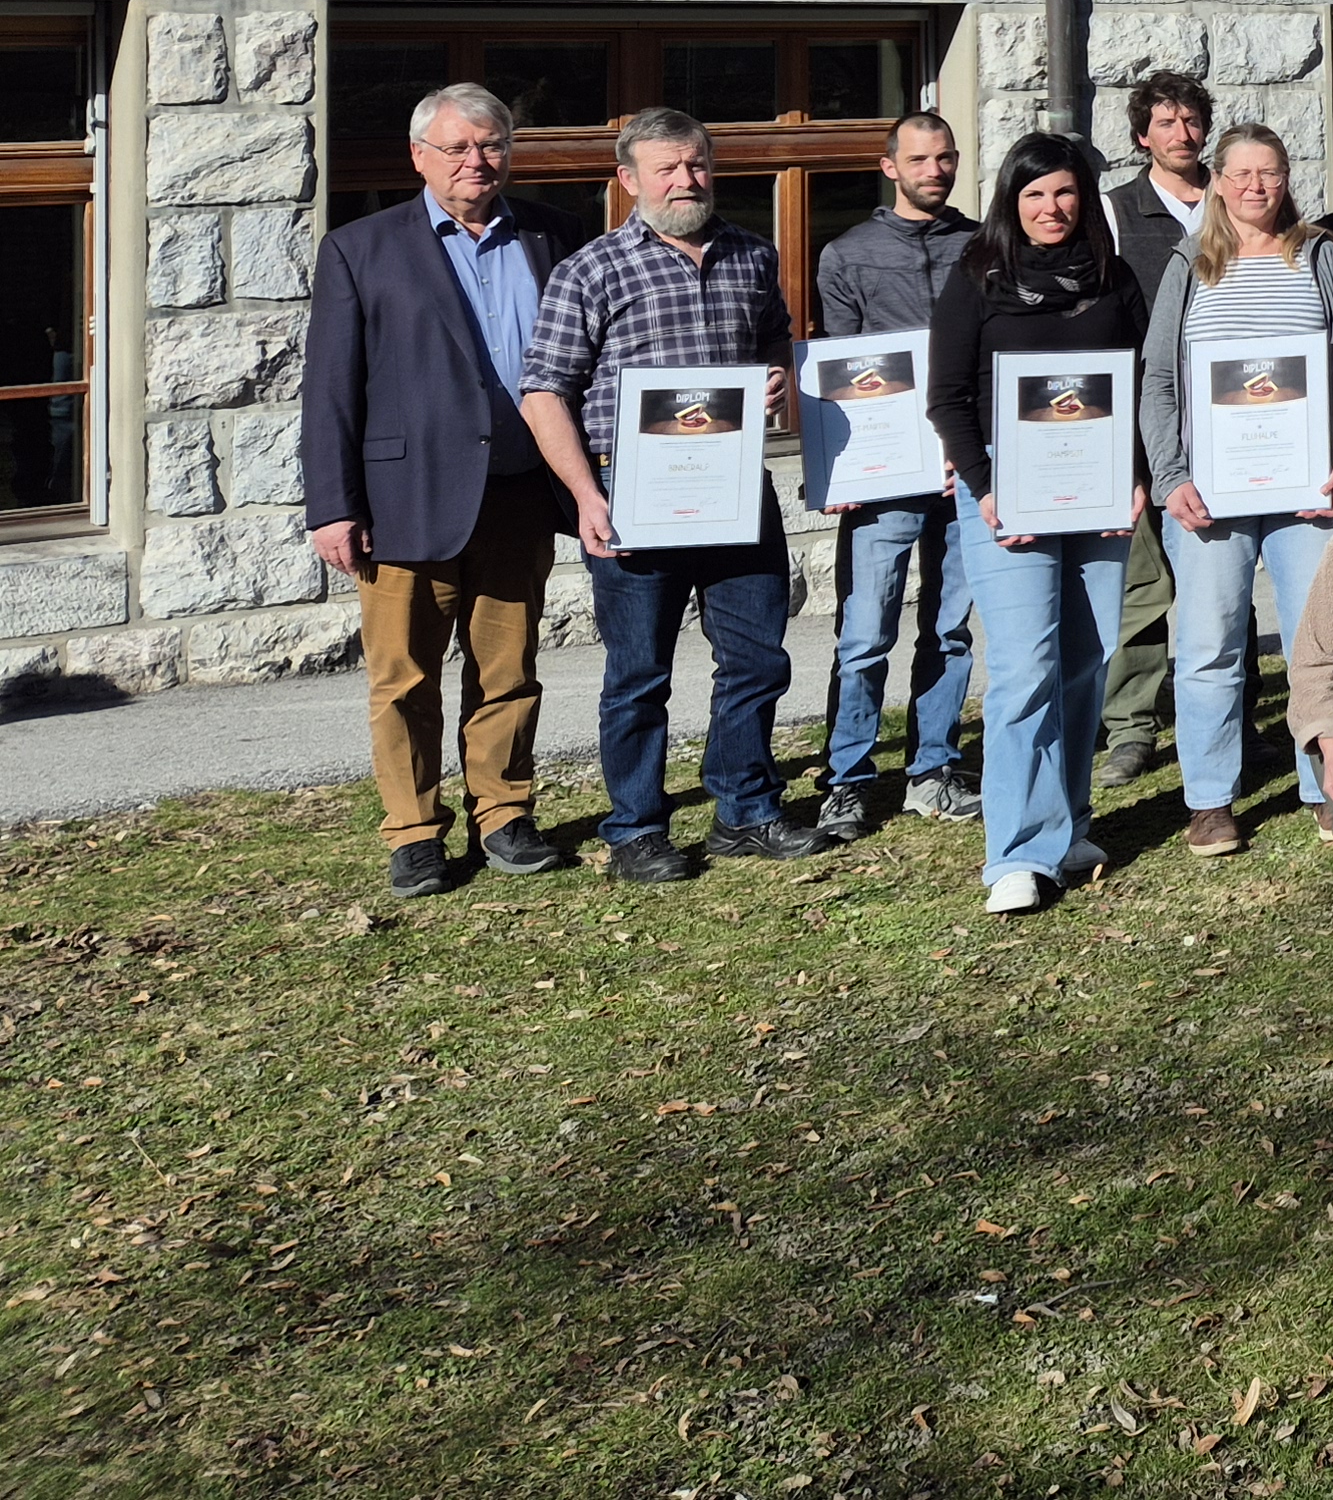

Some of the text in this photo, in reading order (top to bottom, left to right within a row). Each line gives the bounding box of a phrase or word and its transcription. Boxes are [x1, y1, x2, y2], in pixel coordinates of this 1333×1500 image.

[846, 357, 884, 371] DIPLÔME
[1243, 361, 1275, 374] DIPLOM
[1047, 376, 1085, 391] DIPLÔME
[675, 392, 710, 404] DIPLOM
